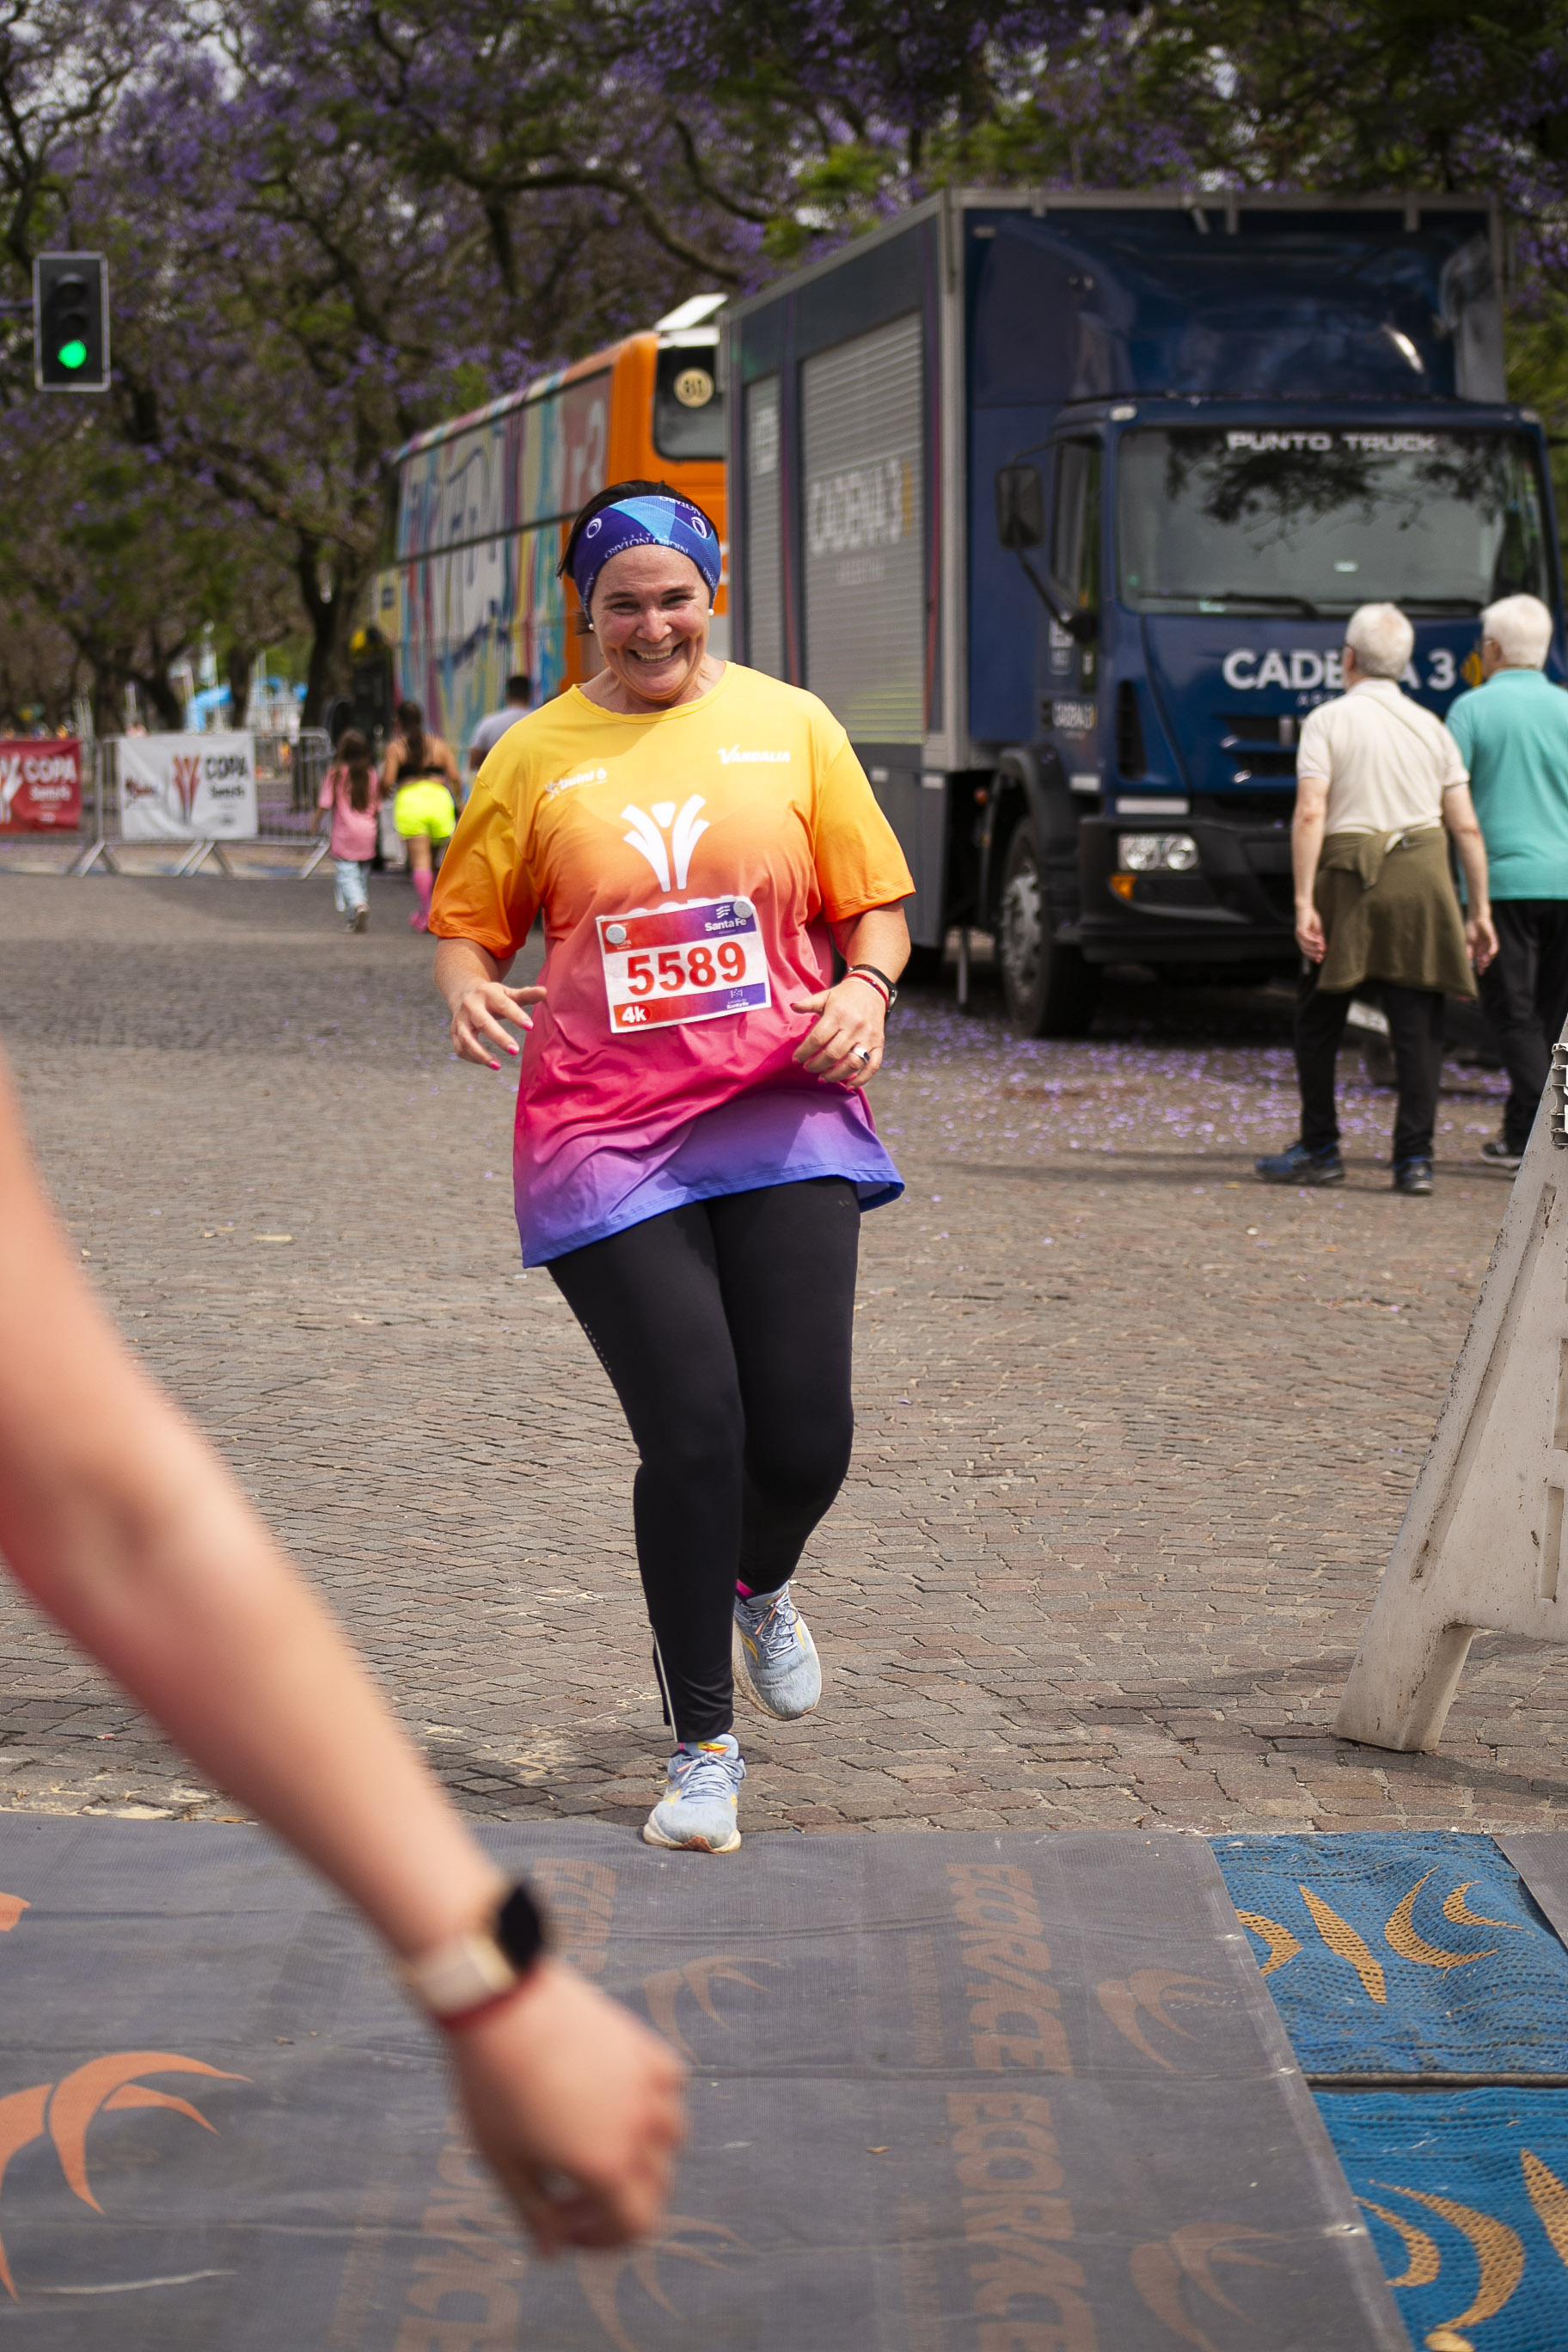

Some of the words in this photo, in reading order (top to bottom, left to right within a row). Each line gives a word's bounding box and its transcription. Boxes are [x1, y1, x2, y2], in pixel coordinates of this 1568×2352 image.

[1228, 432, 1332, 451] PUNTO
[1341, 432, 1438, 452] TRUCK
[604, 536, 649, 559] NOTARO
[1222, 647, 1421, 690] CADEA
[1428, 648, 1456, 690] 3
[24, 755, 78, 782] COPA
[205, 756, 249, 781] COPA
[705, 920, 734, 931] Santa
[734, 917, 747, 927] Fe
[628, 941, 746, 996] 5589
[622, 1006, 646, 1023] 4k
[946, 1864, 1075, 2078] ECORACE
